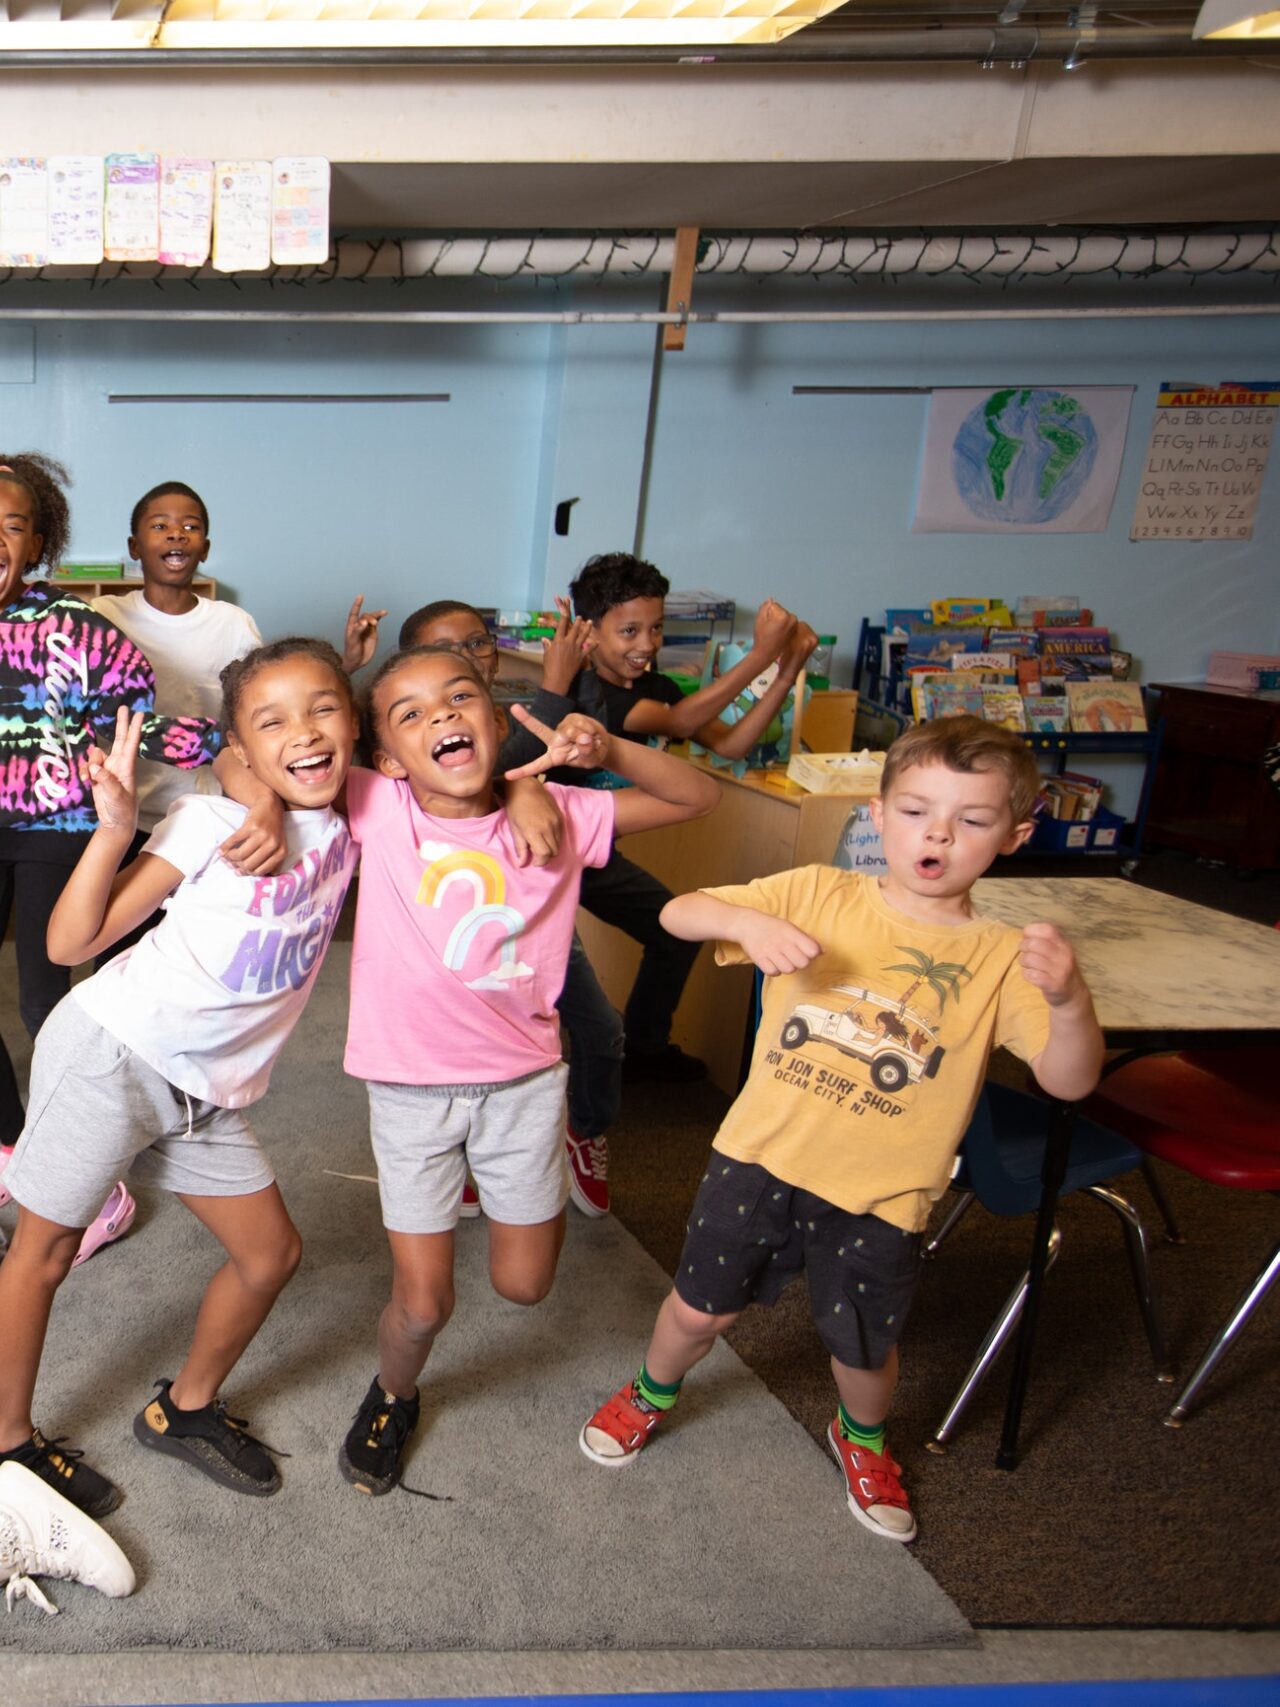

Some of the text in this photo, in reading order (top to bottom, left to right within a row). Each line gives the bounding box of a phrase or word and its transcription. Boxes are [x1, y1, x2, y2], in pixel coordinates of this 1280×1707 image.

[1170, 393, 1269, 405] ALPHABET
[1156, 411, 1273, 425] Aa Bb Cc Dd Ee
[1152, 434, 1270, 454] Ff Gg Hh Ii Jj Kk
[1148, 458, 1264, 476] Ll Mm Nn Oo Pp
[1142, 482, 1165, 500] Qq
[1167, 482, 1183, 496] Rr
[1185, 482, 1200, 496] Ss
[1205, 482, 1219, 496] Tt
[1222, 482, 1240, 496] Uu
[1147, 505, 1245, 525] Ww Xx Yy Zz
[1142, 527, 1149, 536] 2
[1151, 527, 1159, 536] 3
[1175, 527, 1182, 536] 5
[1186, 527, 1193, 536] 6
[1210, 527, 1218, 536] 8
[1237, 527, 1248, 536] 10
[1045, 643, 1105, 654] AMERICA
[34, 632, 88, 811] Justice
[855, 854, 887, 866] Libra
[244, 832, 349, 918] FOLLOW
[296, 901, 316, 924] THE
[765, 1049, 903, 1118] RON JON SURF SHOP
[773, 1069, 809, 1091] OCEAN
[850, 1102, 866, 1116] NJ
